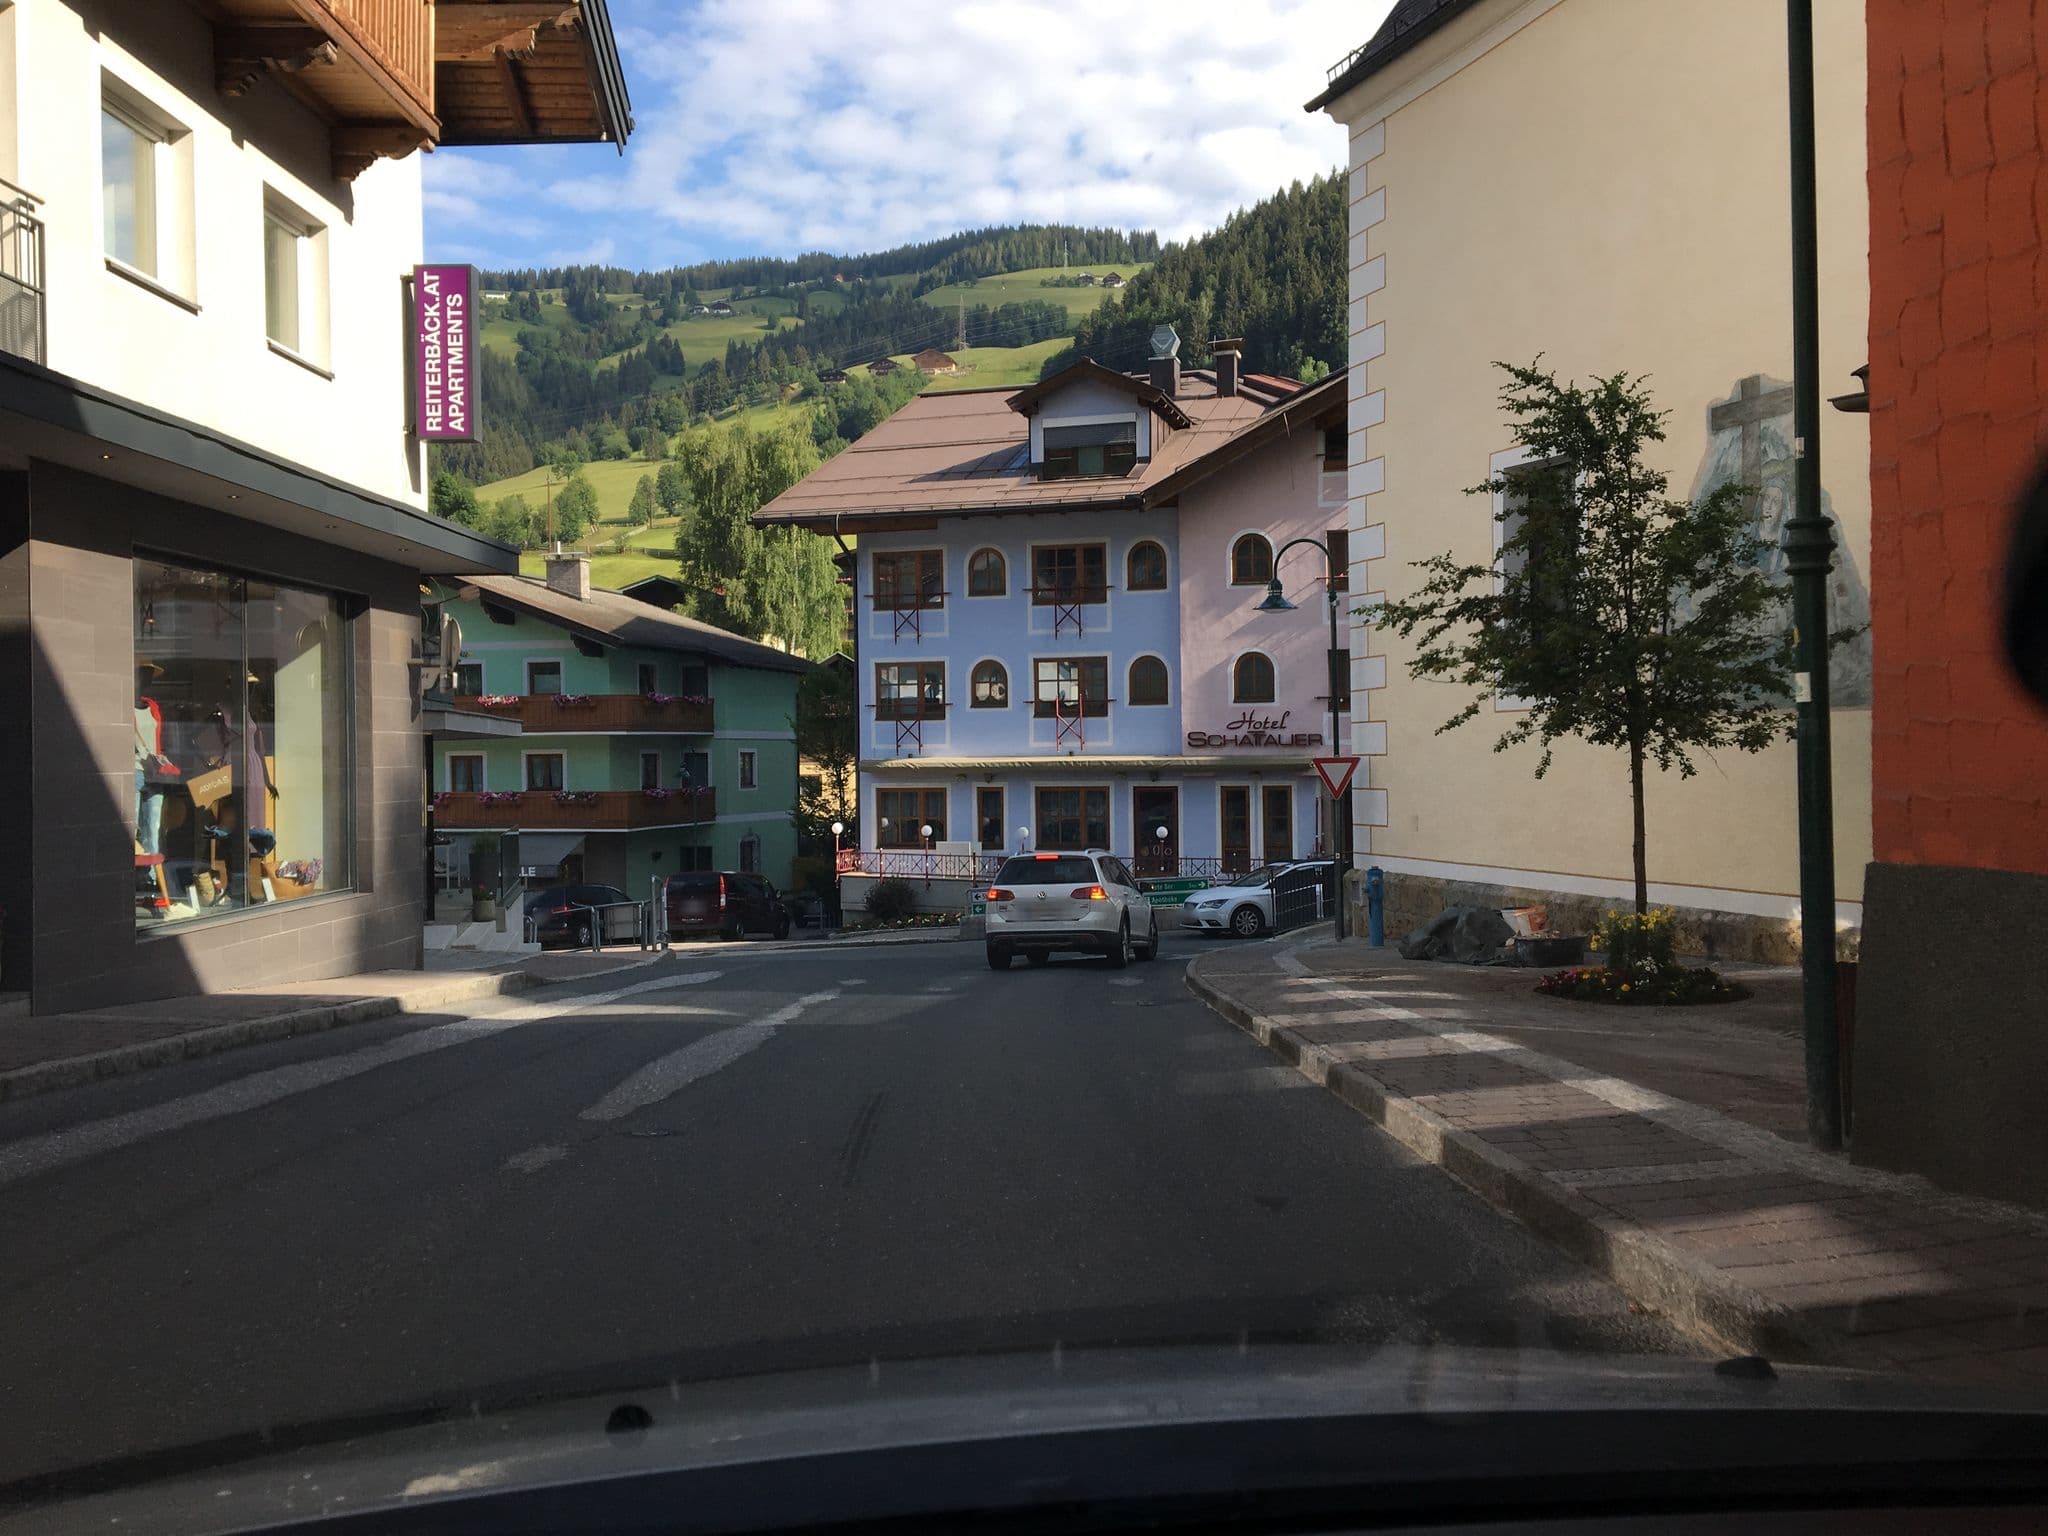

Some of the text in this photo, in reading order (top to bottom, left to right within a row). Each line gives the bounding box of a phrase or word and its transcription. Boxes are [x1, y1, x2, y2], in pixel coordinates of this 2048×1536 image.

[421, 271, 442, 432] REITERBÄCK.AT
[446, 293, 465, 433] APARTMENTS
[1226, 709, 1291, 730] Hotel
